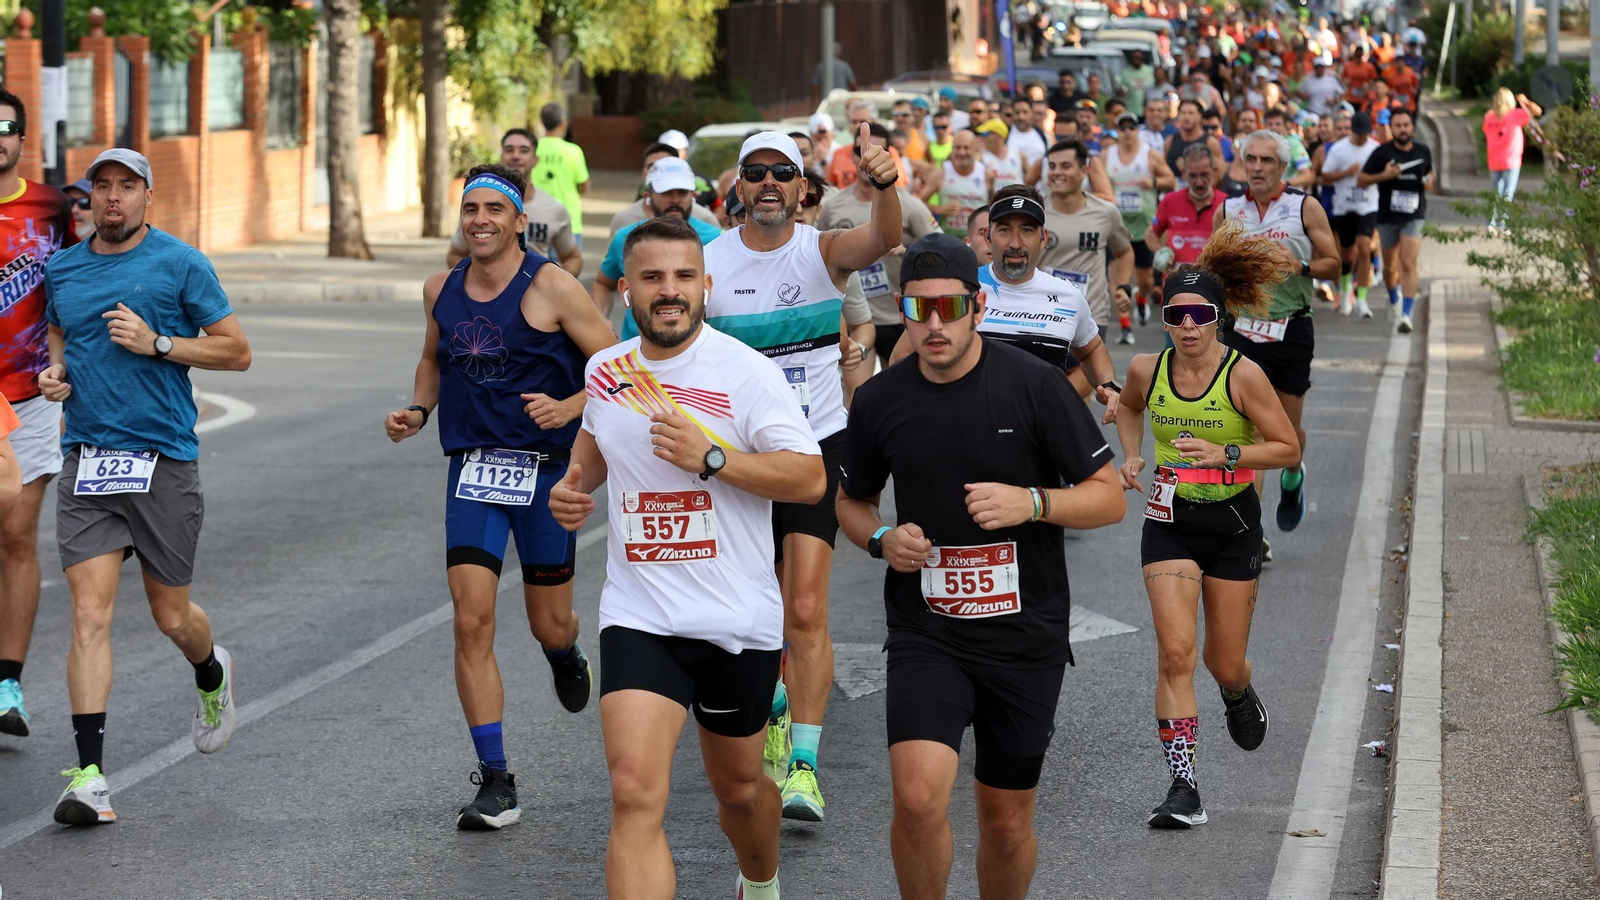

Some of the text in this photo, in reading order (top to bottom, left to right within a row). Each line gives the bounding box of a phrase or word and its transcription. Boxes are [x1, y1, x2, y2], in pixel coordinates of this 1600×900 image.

[1151, 410, 1224, 429] Paparunners
[96, 459, 134, 477] 623
[475, 465, 525, 488] 1129
[102, 480, 144, 492] MIZUNO
[484, 490, 527, 503] MIZUNO
[644, 502, 667, 511] XXIX
[642, 515, 690, 540] 557
[655, 547, 712, 560] MIZUNO
[946, 557, 970, 566] XXIX
[945, 570, 994, 595] 555
[958, 600, 1013, 614] MIZUNO
